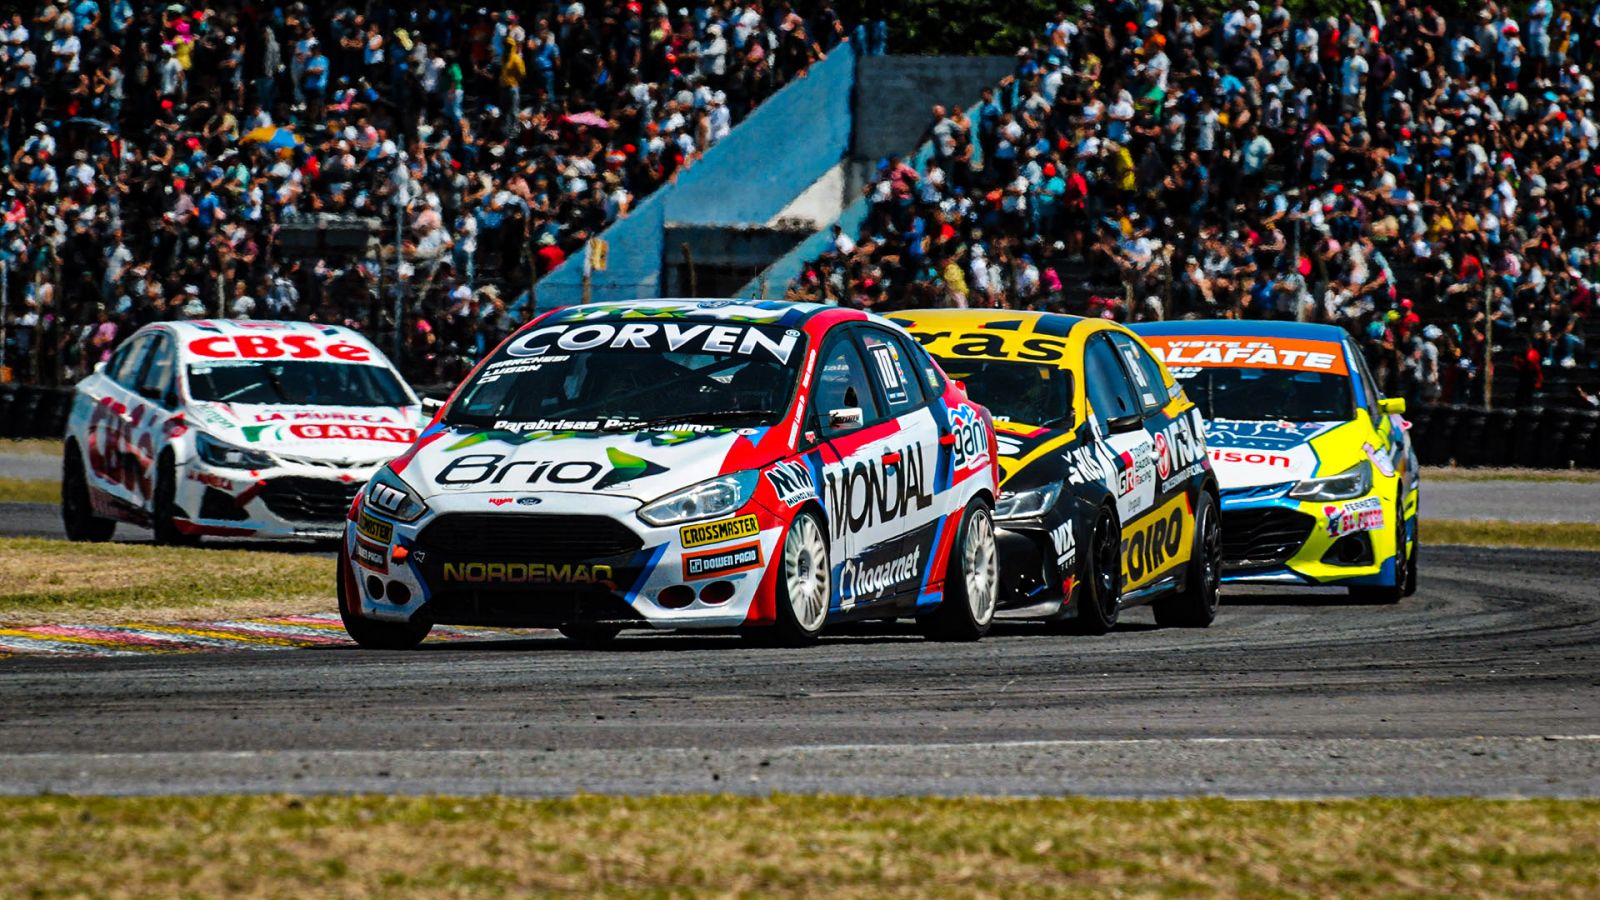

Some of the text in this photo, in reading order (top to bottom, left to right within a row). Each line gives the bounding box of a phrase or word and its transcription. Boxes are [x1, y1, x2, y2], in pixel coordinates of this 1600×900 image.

[1168, 341, 1241, 349] VISITE
[873, 348, 898, 388] 10
[300, 425, 413, 441] GARAY
[494, 419, 600, 434] Parabrisas
[1207, 449, 1289, 467] ison
[371, 483, 407, 511] 10
[826, 441, 932, 541] MONDIAL
[1118, 469, 1134, 498] GR
[683, 517, 757, 544] CROSSMASTER
[1050, 519, 1076, 555] WIX
[856, 544, 921, 598] hogarnet
